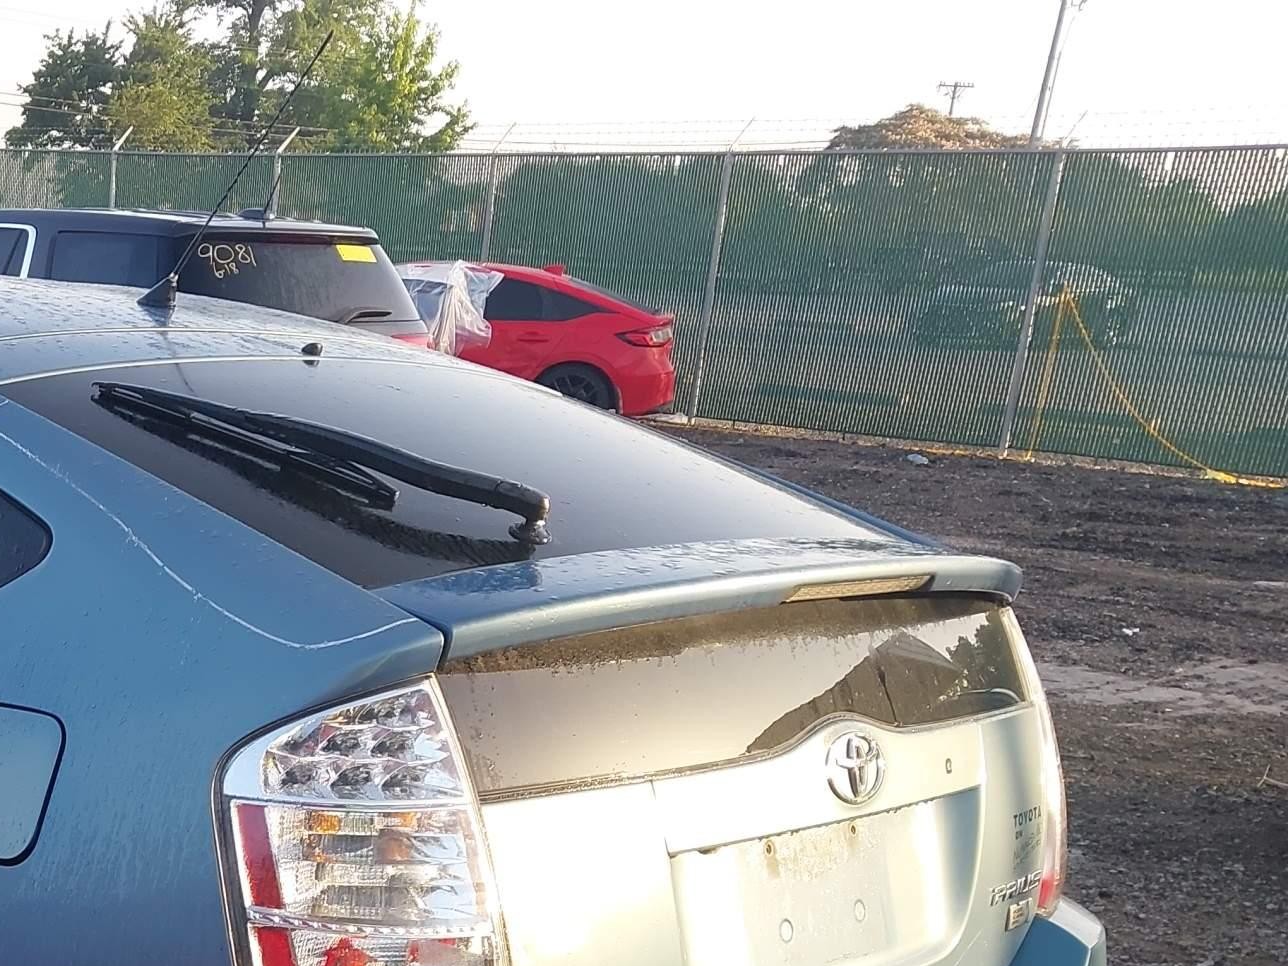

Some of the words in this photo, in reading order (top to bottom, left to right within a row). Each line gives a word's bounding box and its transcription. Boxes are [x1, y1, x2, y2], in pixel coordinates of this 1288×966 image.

[197, 243, 257, 267] 9081
[1013, 805, 1042, 829] TOYOTA
[989, 869, 1043, 907] PRIUS
